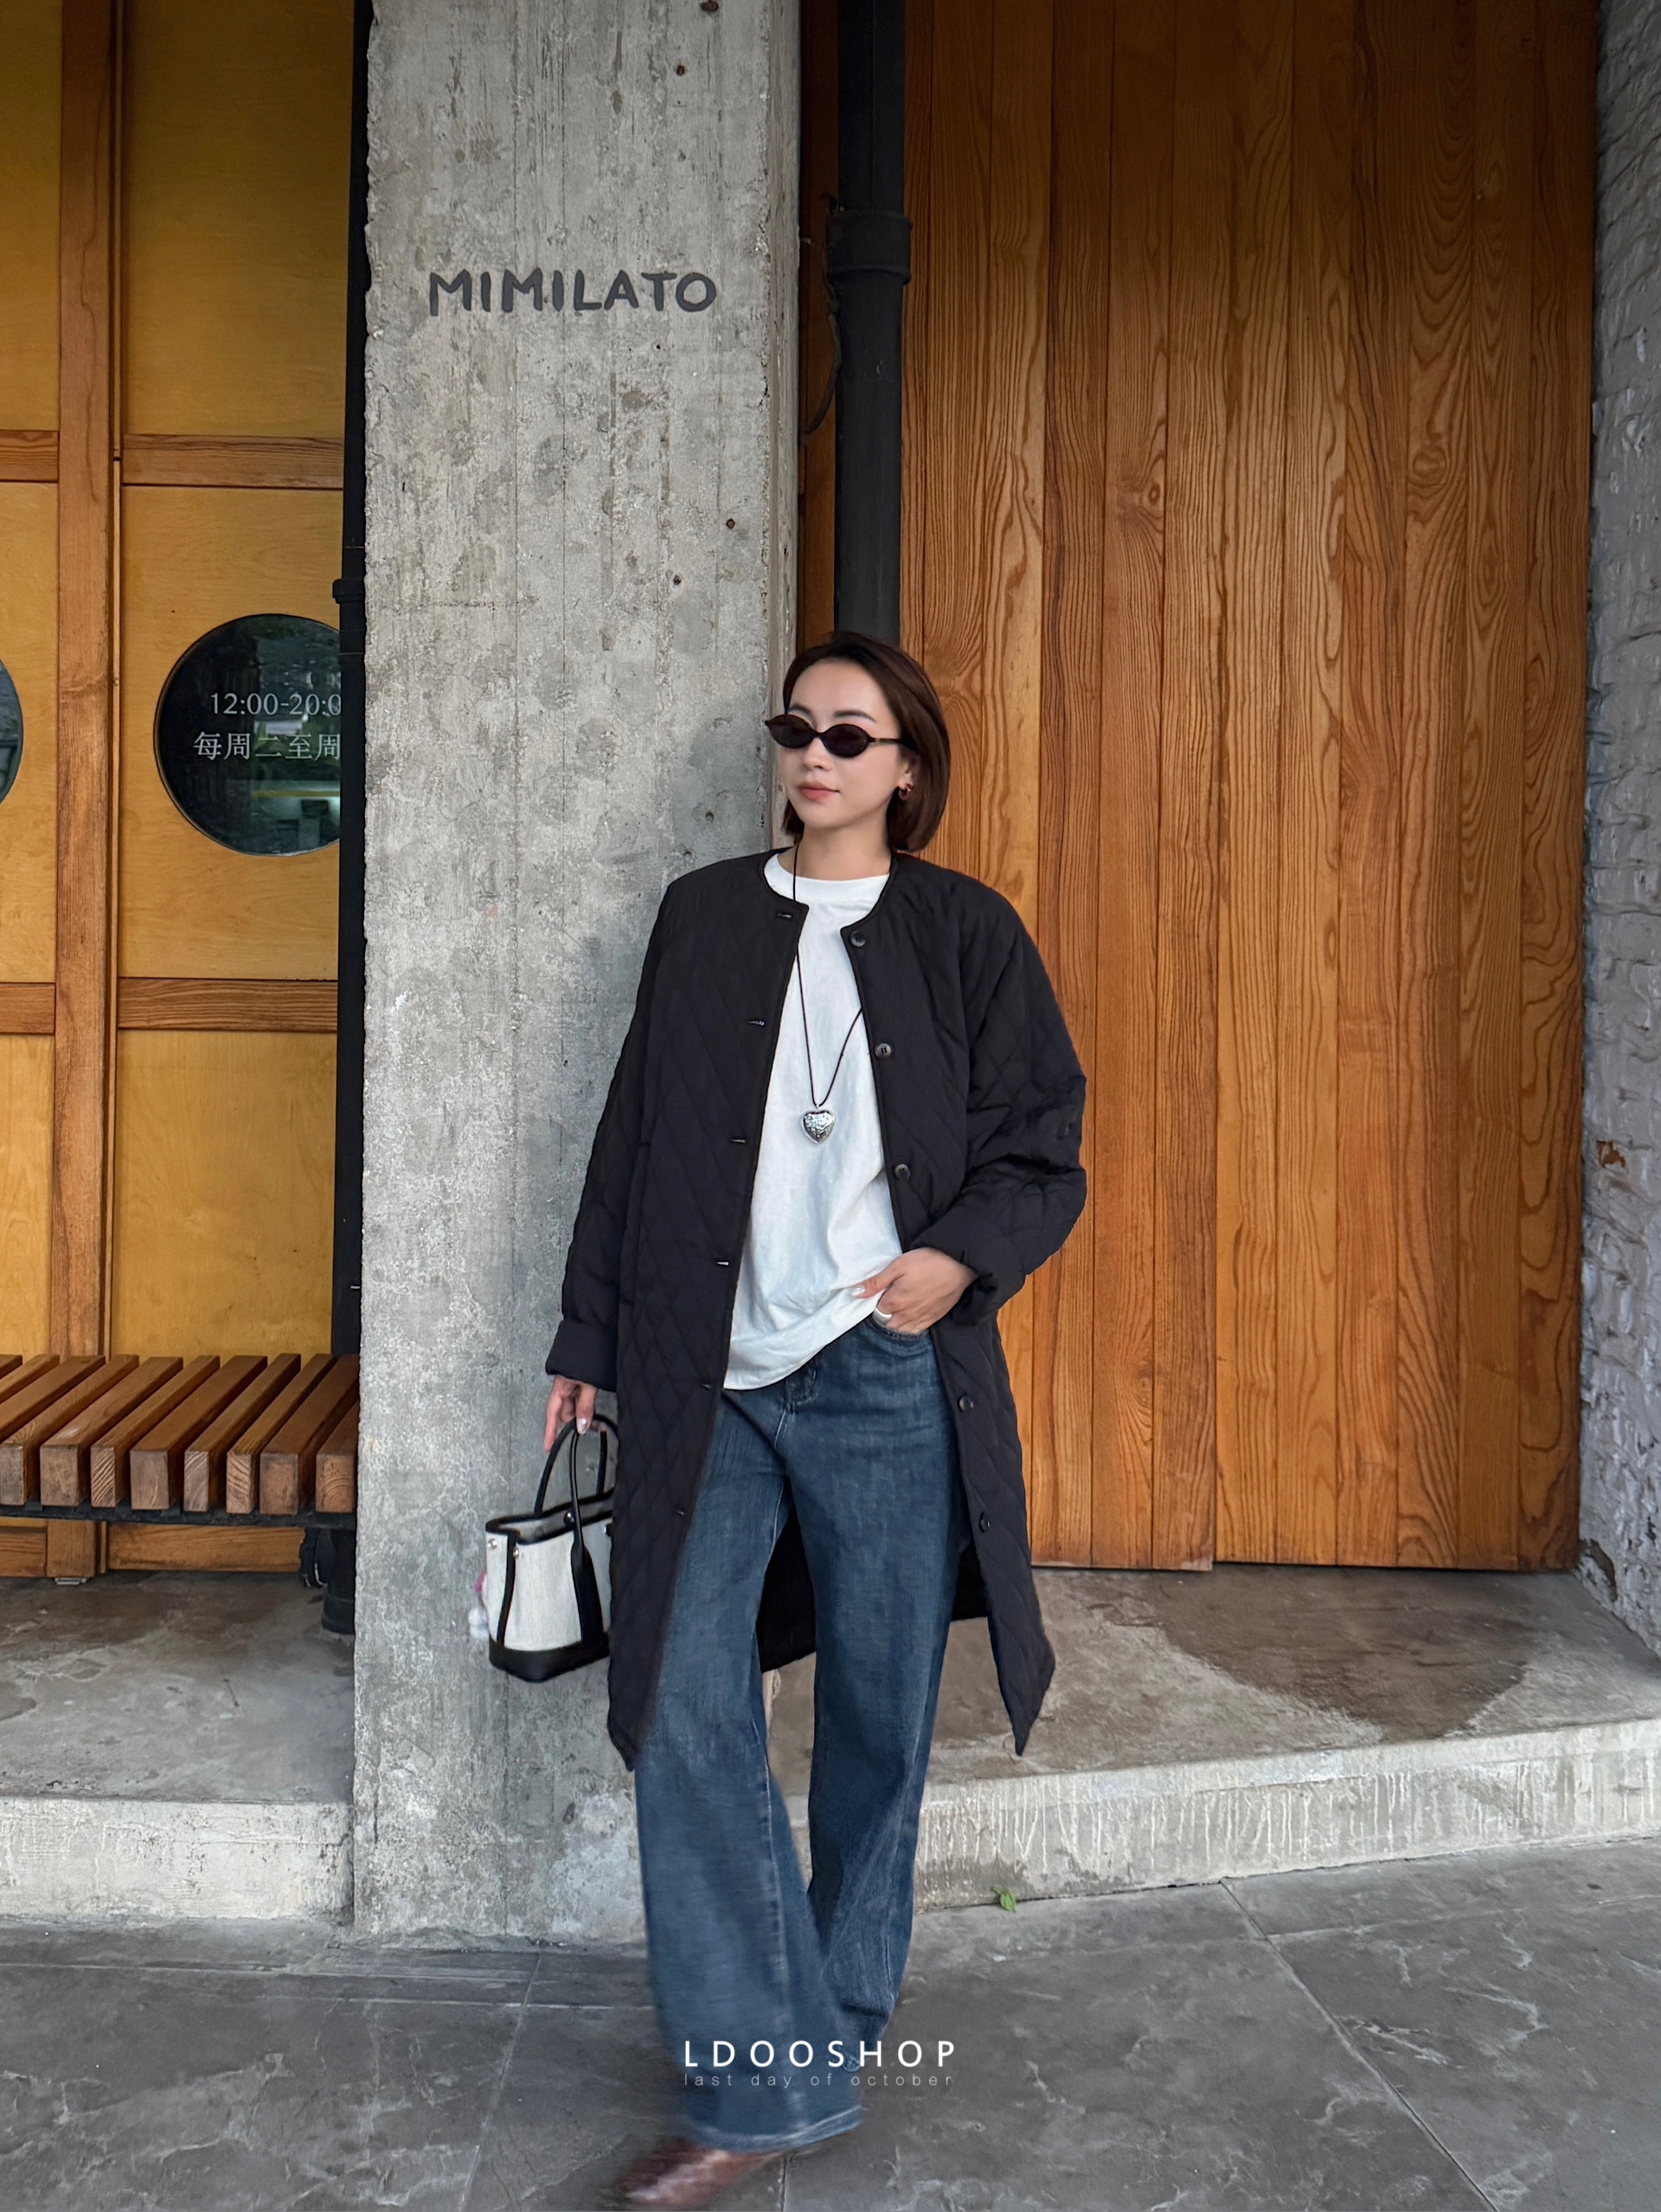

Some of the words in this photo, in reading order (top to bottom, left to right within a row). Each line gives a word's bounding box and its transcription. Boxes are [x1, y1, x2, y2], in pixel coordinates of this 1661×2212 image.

[429, 266, 717, 317] MIMILATO
[193, 731, 341, 761] 每周二至周
